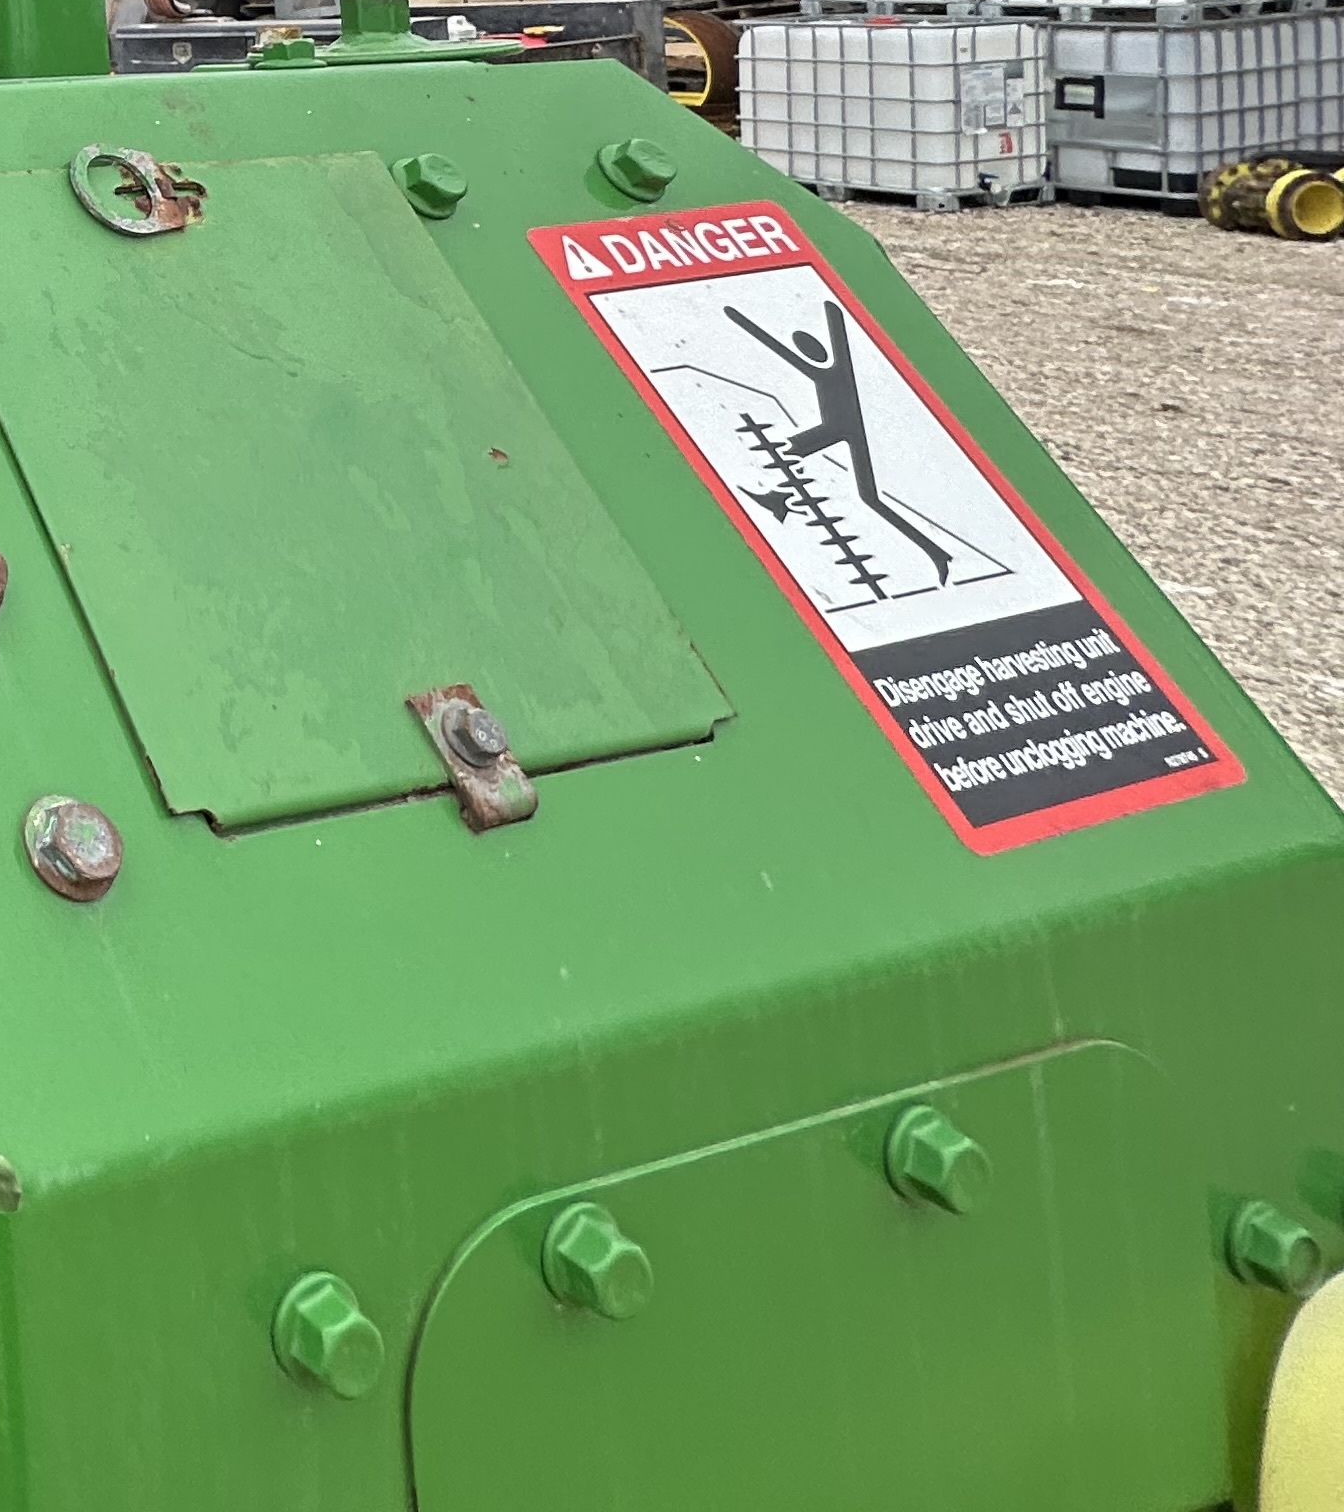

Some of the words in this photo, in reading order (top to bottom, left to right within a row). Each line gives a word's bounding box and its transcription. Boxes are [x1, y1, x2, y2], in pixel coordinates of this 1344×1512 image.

[599, 215, 801, 274] DANGER
[872, 662, 986, 708] Disengage
[973, 640, 1088, 683] harvesting
[1082, 627, 1122, 659] unit
[908, 715, 968, 750] drive
[963, 699, 1010, 736] and
[1007, 689, 1059, 726] shut
[1051, 680, 1088, 713] off
[1079, 669, 1153, 706] engine
[932, 754, 1008, 793] before
[998, 728, 1114, 771] unclogging
[1102, 708, 1188, 750] machine.
